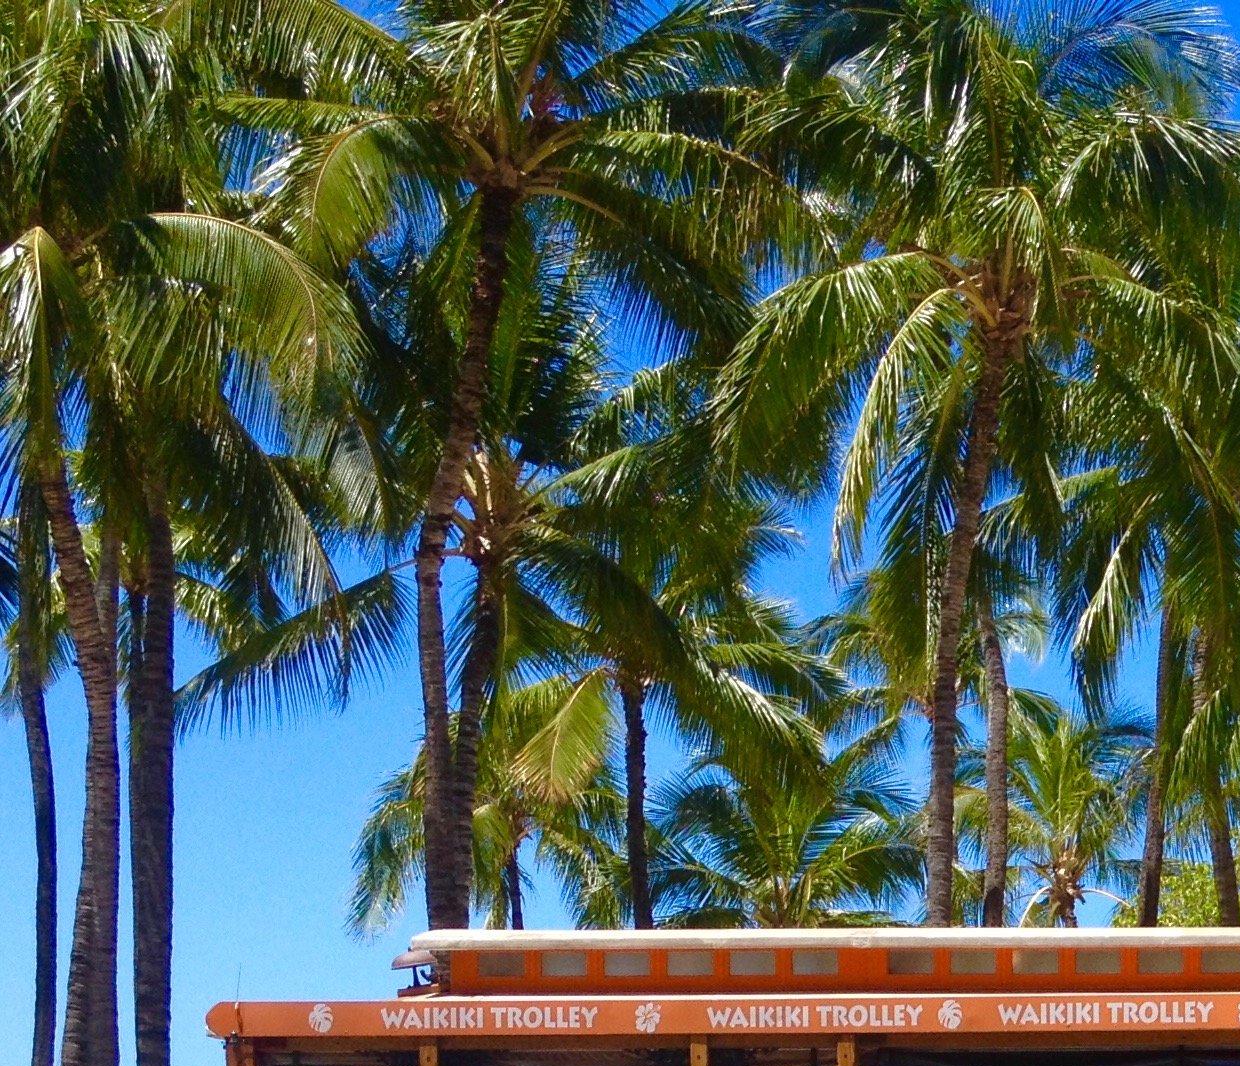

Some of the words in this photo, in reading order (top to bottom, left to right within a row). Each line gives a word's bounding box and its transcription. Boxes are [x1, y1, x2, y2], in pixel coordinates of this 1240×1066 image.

[380, 1007, 484, 1029] WAIKIKI
[490, 1006, 598, 1028] TROLLEY
[707, 1005, 809, 1028] WAIKIKI
[816, 1004, 923, 1027] TROLLEY
[998, 1002, 1100, 1025] WAIKIKI
[1107, 1001, 1214, 1024] TROLLEY
